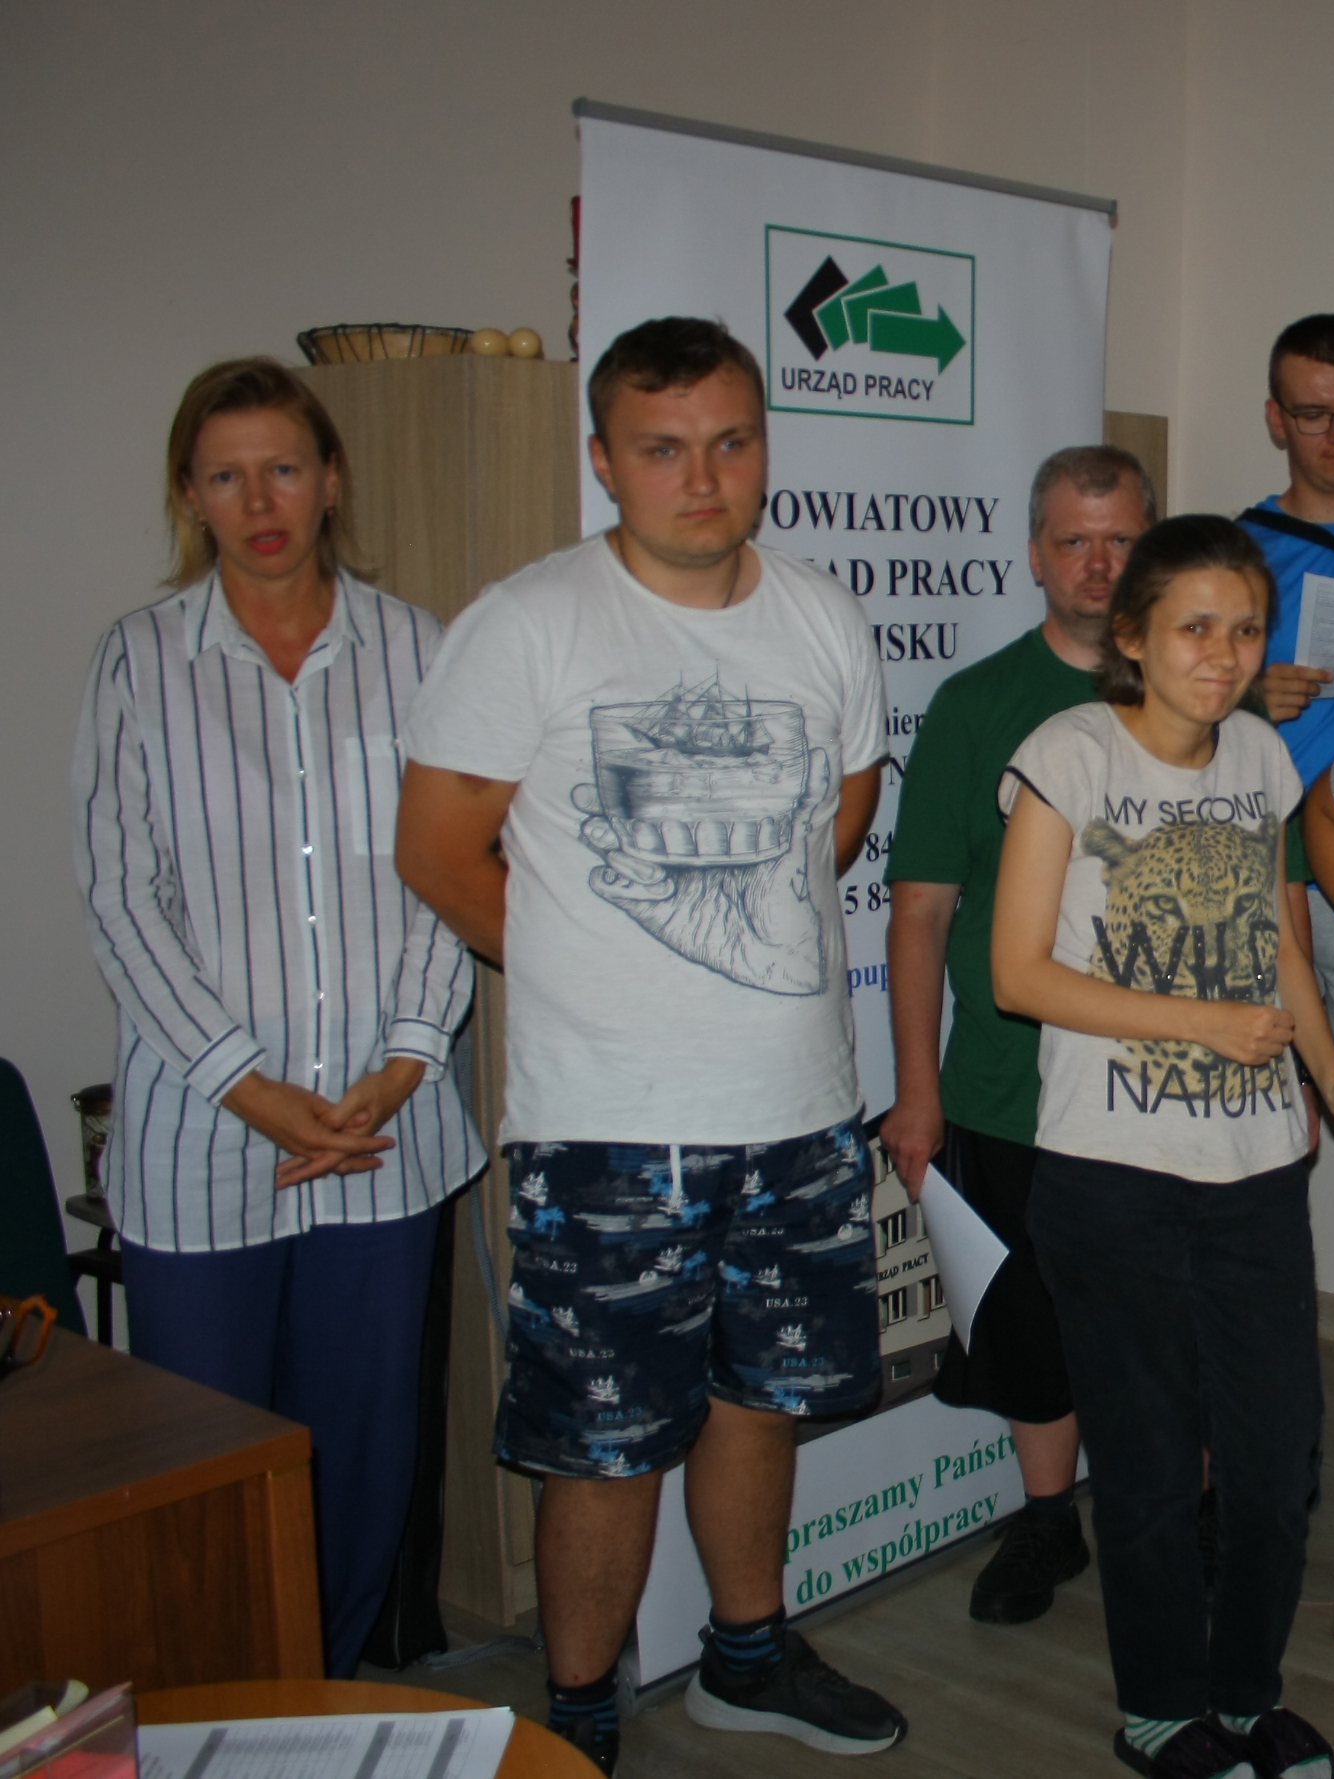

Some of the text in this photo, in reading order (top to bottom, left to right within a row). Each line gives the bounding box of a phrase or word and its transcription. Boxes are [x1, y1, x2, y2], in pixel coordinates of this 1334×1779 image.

[780, 366, 935, 401] URZĄD PRACY
[761, 488, 1000, 534] OWIATOWY
[887, 557, 1014, 597] PRACY
[871, 621, 960, 661] ISKU
[1104, 790, 1269, 827] MY SECOND
[844, 884, 859, 916] 5
[1090, 914, 1279, 1002] WILD
[1106, 1056, 1292, 1119] NATURE
[876, 1252, 930, 1282] RZĄD PRACY
[765, 1296, 808, 1309] USA.23
[783, 1472, 925, 1565] praszamy
[796, 1491, 999, 1606] do współpracy
